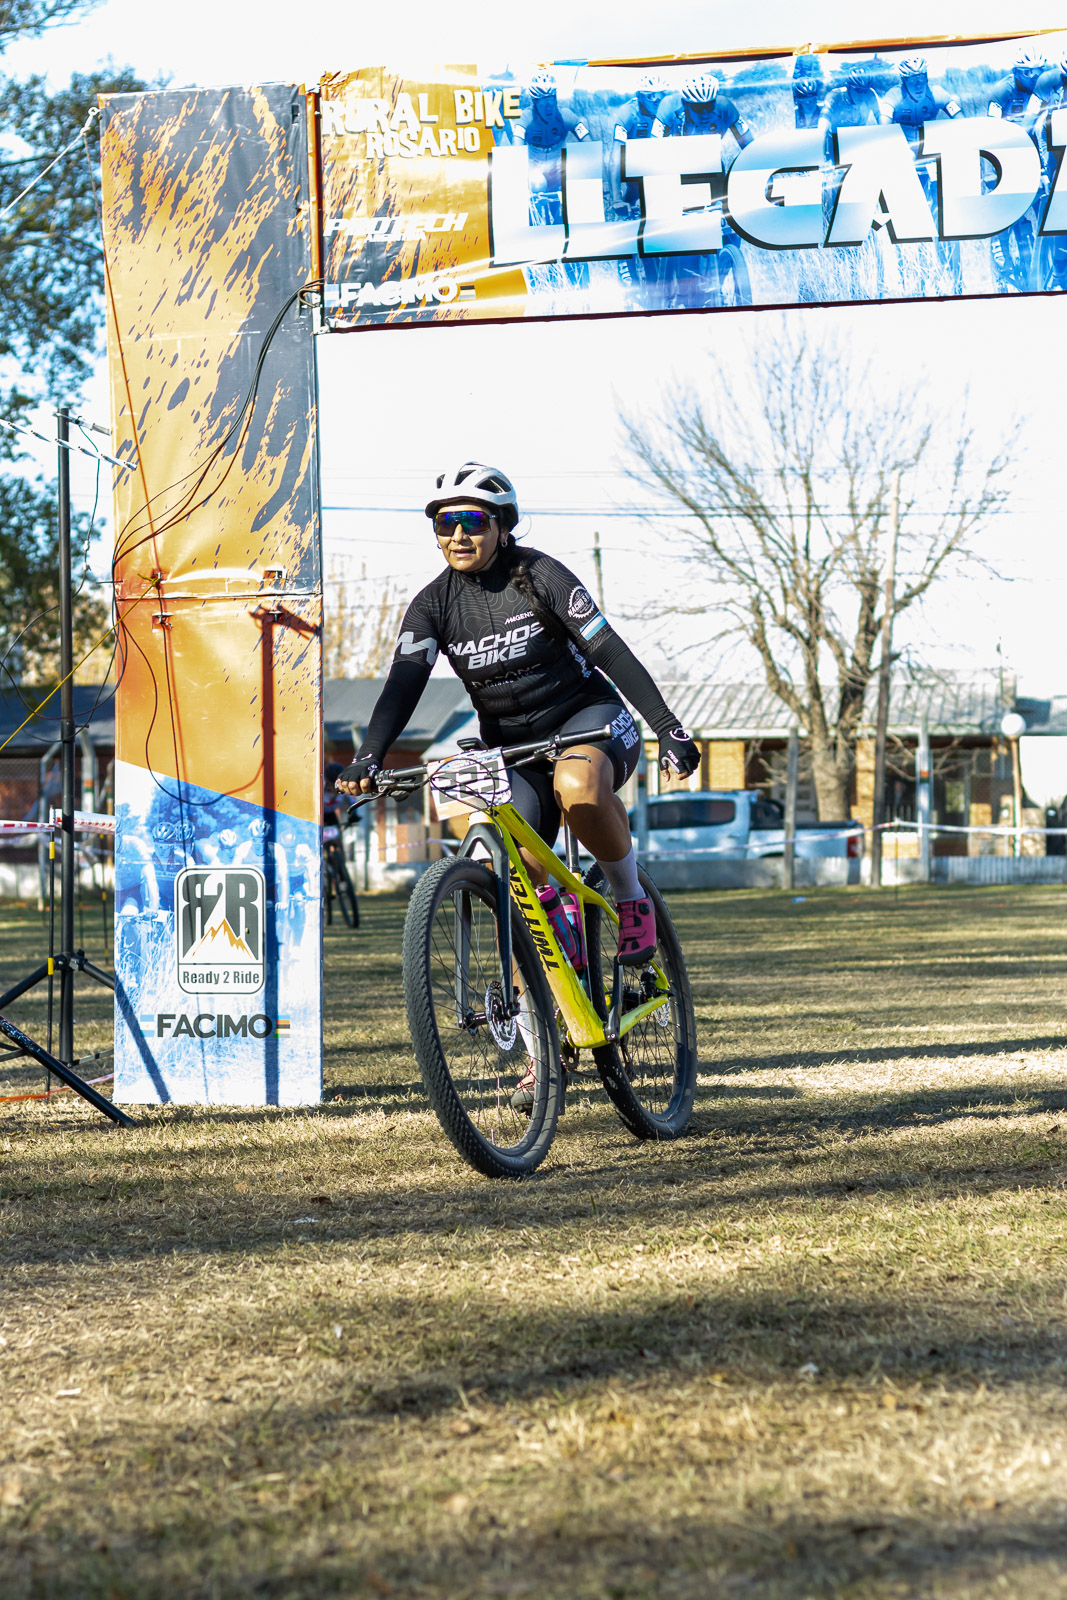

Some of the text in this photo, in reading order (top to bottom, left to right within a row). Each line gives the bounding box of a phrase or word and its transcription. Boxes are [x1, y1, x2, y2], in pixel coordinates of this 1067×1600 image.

[320, 86, 522, 136] RURAL BIKE
[366, 127, 481, 159] ROSARIO
[340, 277, 458, 307] FACIMO
[447, 621, 545, 656] NACHOS
[468, 641, 528, 670] BIKE
[611, 709, 633, 741] ACHOS
[620, 726, 640, 750] BIKE
[183, 971, 260, 985] Ready 2 Ride
[157, 1013, 273, 1039] FACIMO
